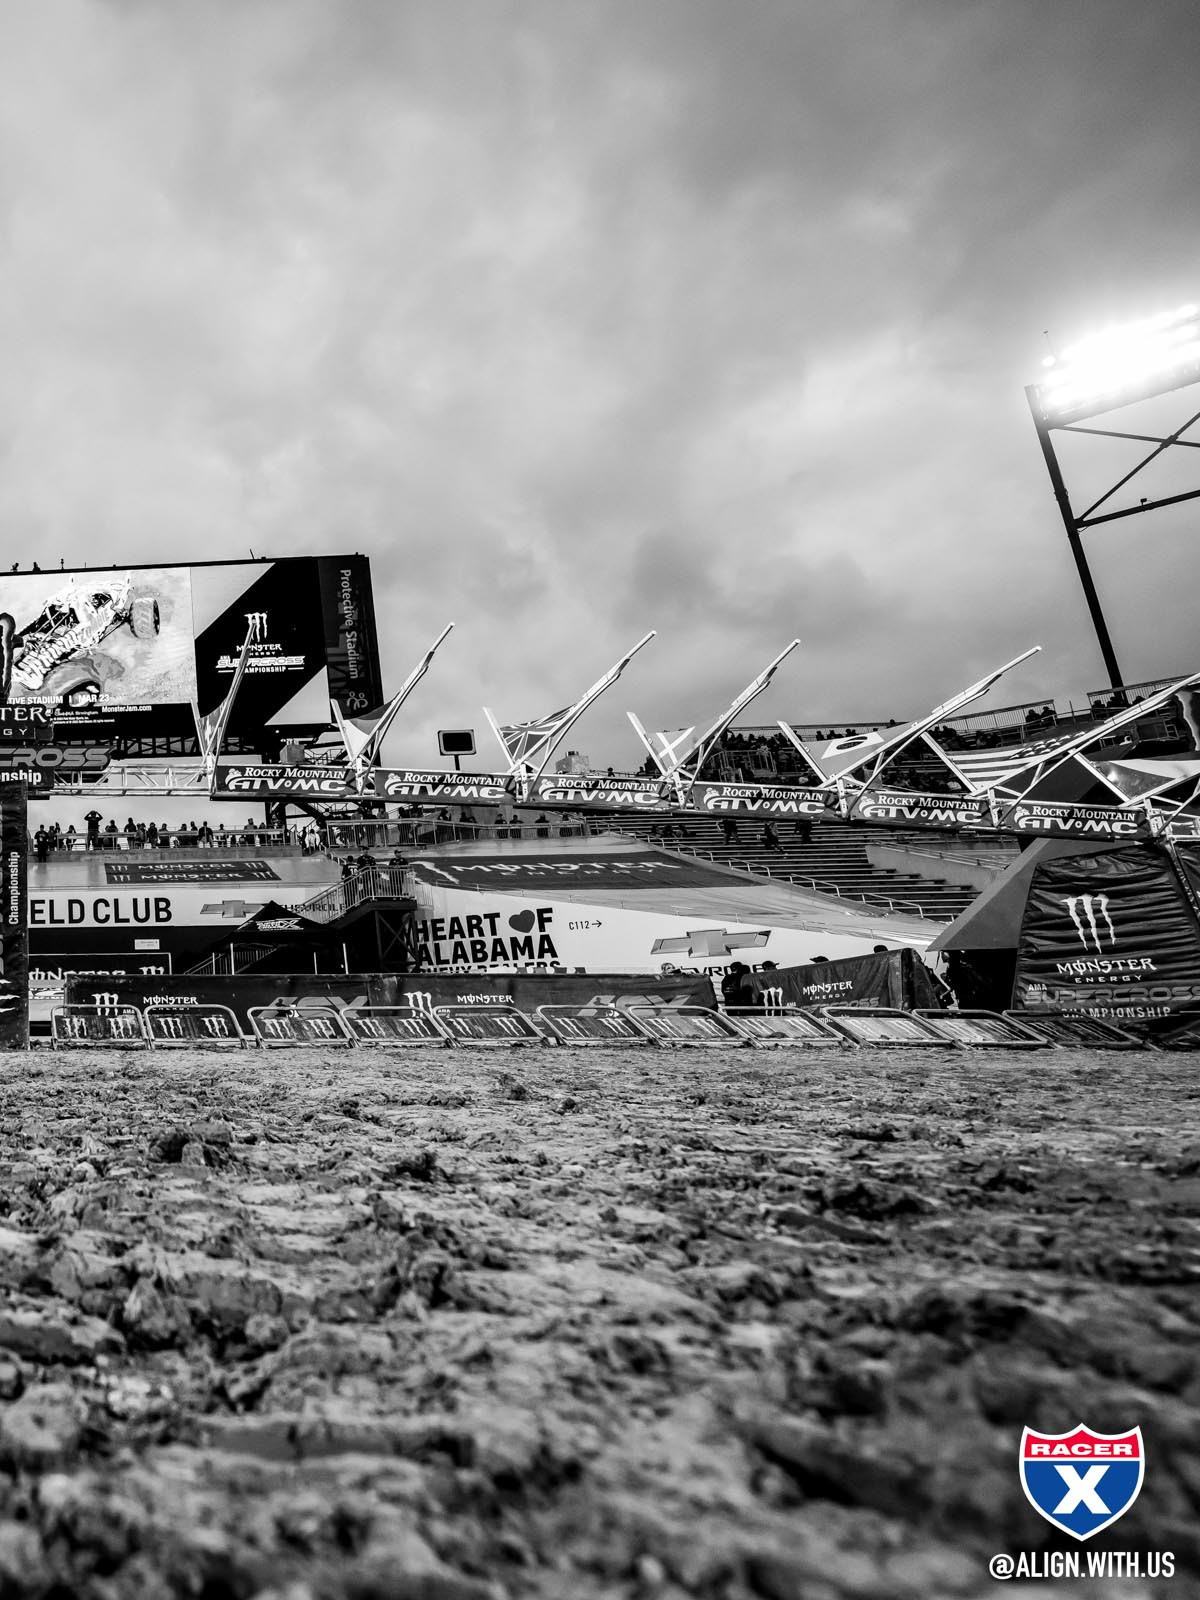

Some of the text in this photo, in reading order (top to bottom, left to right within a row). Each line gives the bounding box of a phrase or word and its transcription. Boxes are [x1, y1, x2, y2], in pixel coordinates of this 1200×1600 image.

[340, 569, 360, 679] Protective Stadium
[236, 644, 282, 652] MNSTER
[216, 656, 305, 668] SUPRCROSS
[28, 695, 63, 705] STADIUM
[78, 694, 98, 704] MAR
[99, 693, 110, 703] 23
[101, 704, 152, 713] MonsterJam.com
[244, 767, 346, 779] ROCKY MOUNTAIN
[403, 772, 505, 786] ROCKY MOUNTAIN
[557, 778, 658, 791] ROCKY MOUNTAIN
[722, 787, 823, 800] ROCKY MOUNTAIN
[878, 795, 980, 810] ROCKY MOUNTAIN
[1032, 806, 1135, 821] ROCKY MOUNTAIN
[451, 861, 681, 872] MONSTER
[8, 851, 20, 925] Championship
[30, 899, 85, 924] ELD
[93, 897, 172, 924] CLUB
[415, 912, 501, 943] HEART
[569, 920, 590, 931] C112
[419, 934, 559, 966] ALABAMA
[1056, 958, 1157, 976] MONSTER
[1075, 975, 1143, 983] ENERGY
[802, 981, 853, 996] MONSTER
[143, 995, 198, 1005] MONSTER
[457, 993, 515, 1004] MONSTER
